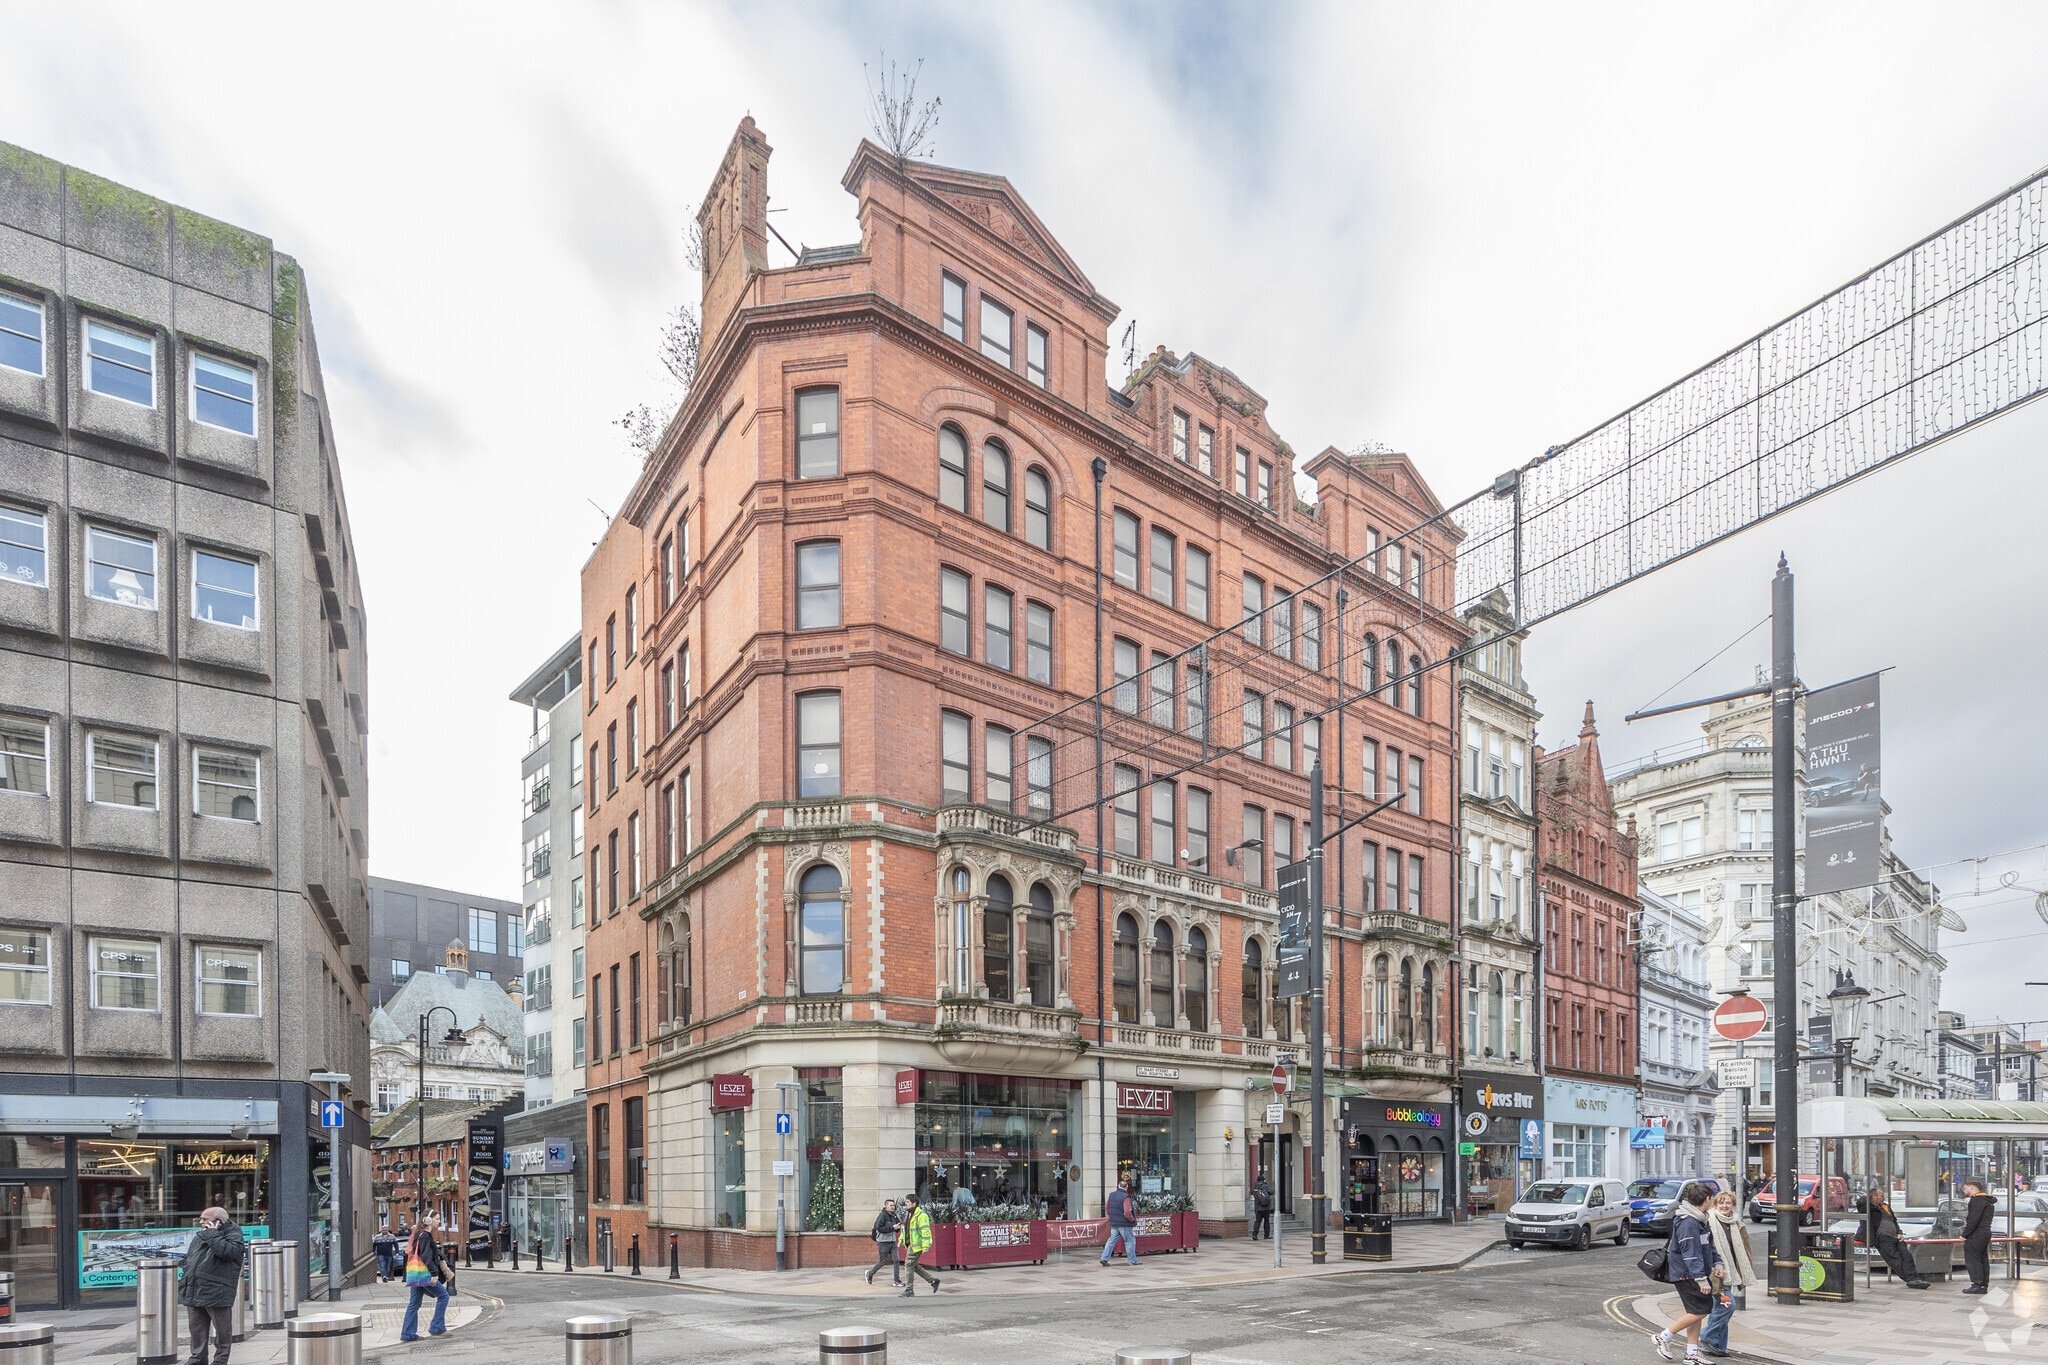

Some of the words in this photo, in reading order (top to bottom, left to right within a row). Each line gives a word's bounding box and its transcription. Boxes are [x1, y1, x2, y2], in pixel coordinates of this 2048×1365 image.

[1809, 752, 1818, 761] A
[1821, 743, 1848, 758] THU
[1810, 752, 1851, 770] HWNT.
[100, 951, 127, 960] CPS
[205, 958, 230, 967] CPS
[1514, 1092, 1534, 1108] HUT
[1386, 1107, 1441, 1127] Bubbleology
[981, 1228, 1009, 1237] COCKTAILS
[89, 1274, 137, 1283] Contempo
